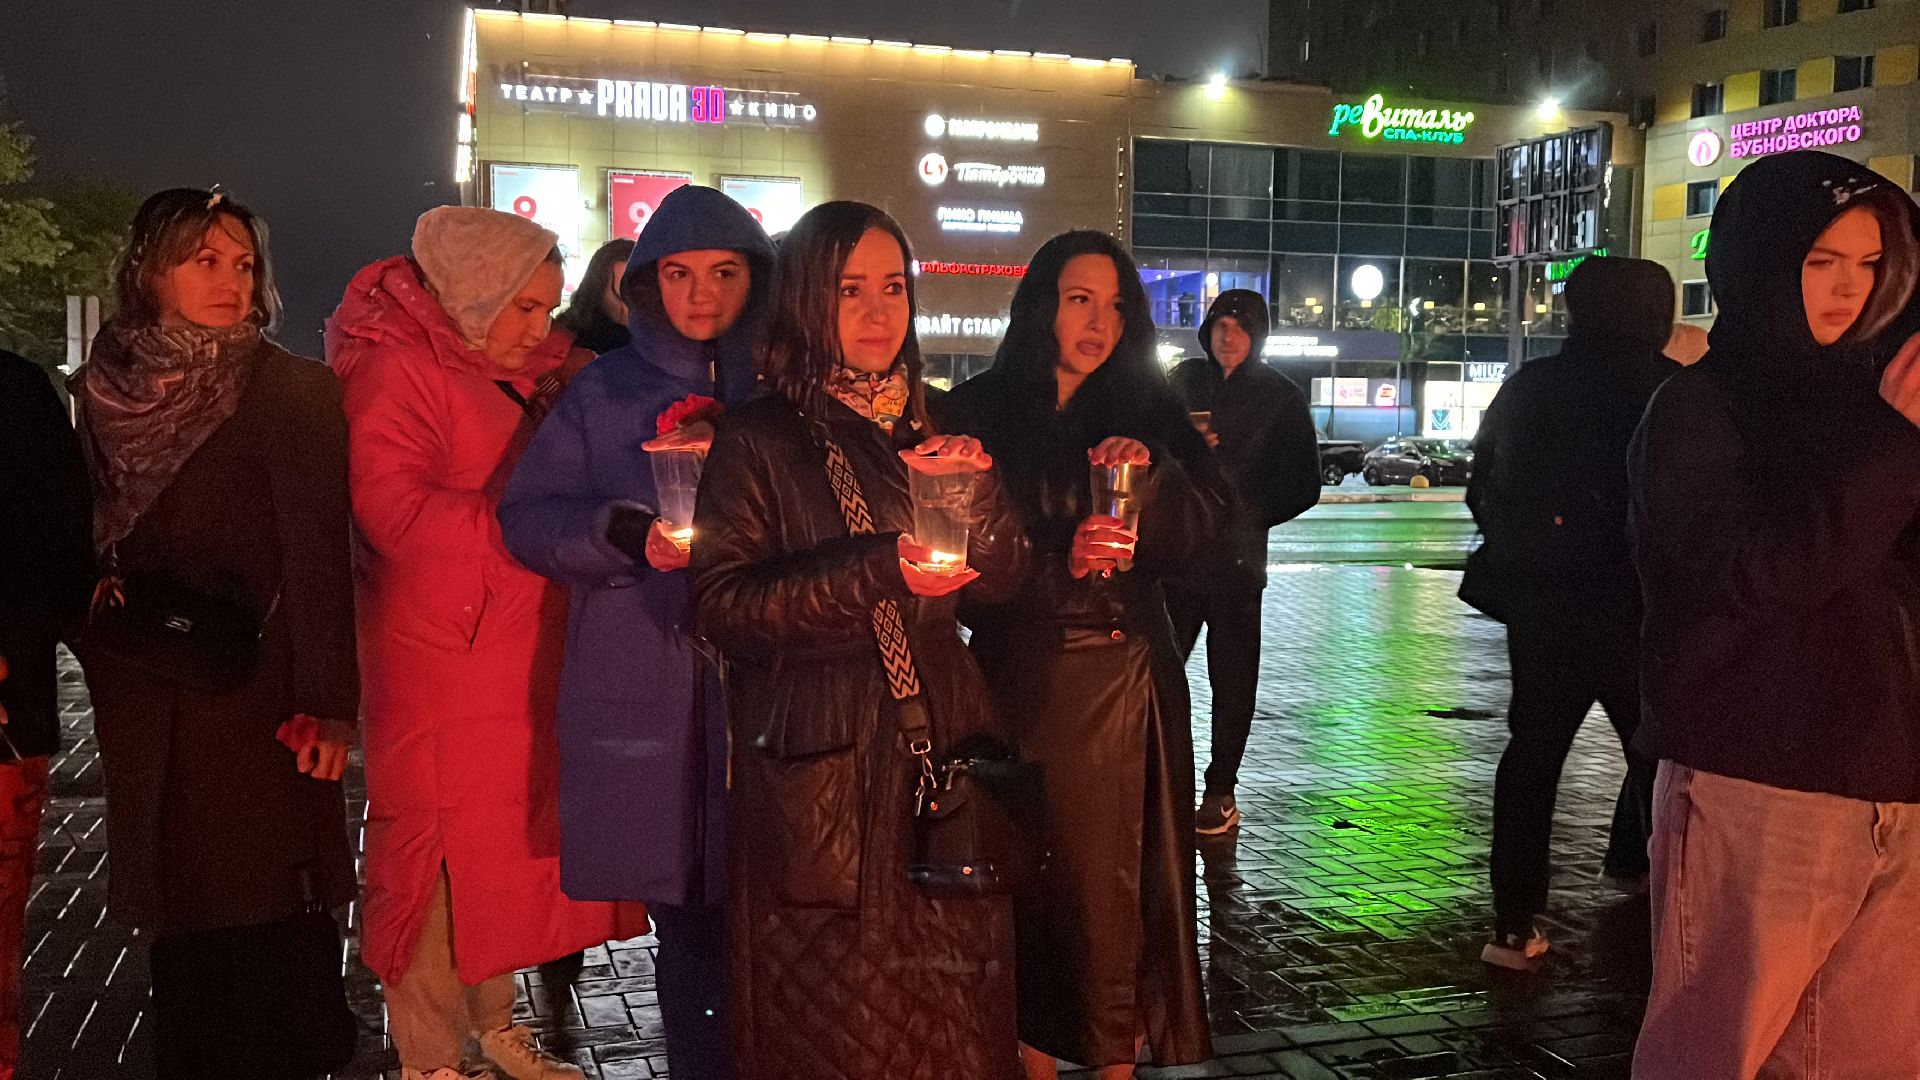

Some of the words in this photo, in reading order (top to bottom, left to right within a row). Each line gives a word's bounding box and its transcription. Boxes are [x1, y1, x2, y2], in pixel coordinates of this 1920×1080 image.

[501, 84, 572, 103] ТЕАТР
[597, 79, 687, 122] PRADA
[691, 86, 725, 124] 3D
[748, 101, 817, 120] КИНО
[1730, 118, 1782, 140] ЦЕНТР
[1784, 105, 1861, 133] ДОКТОРА
[1383, 128, 1465, 144] СПА-КЛУБ
[1730, 125, 1861, 158] БУБНОВСКОГО
[922, 261, 1028, 277] АЛЬФАСТРАХОВА
[1469, 363, 1506, 378] MIUZ
